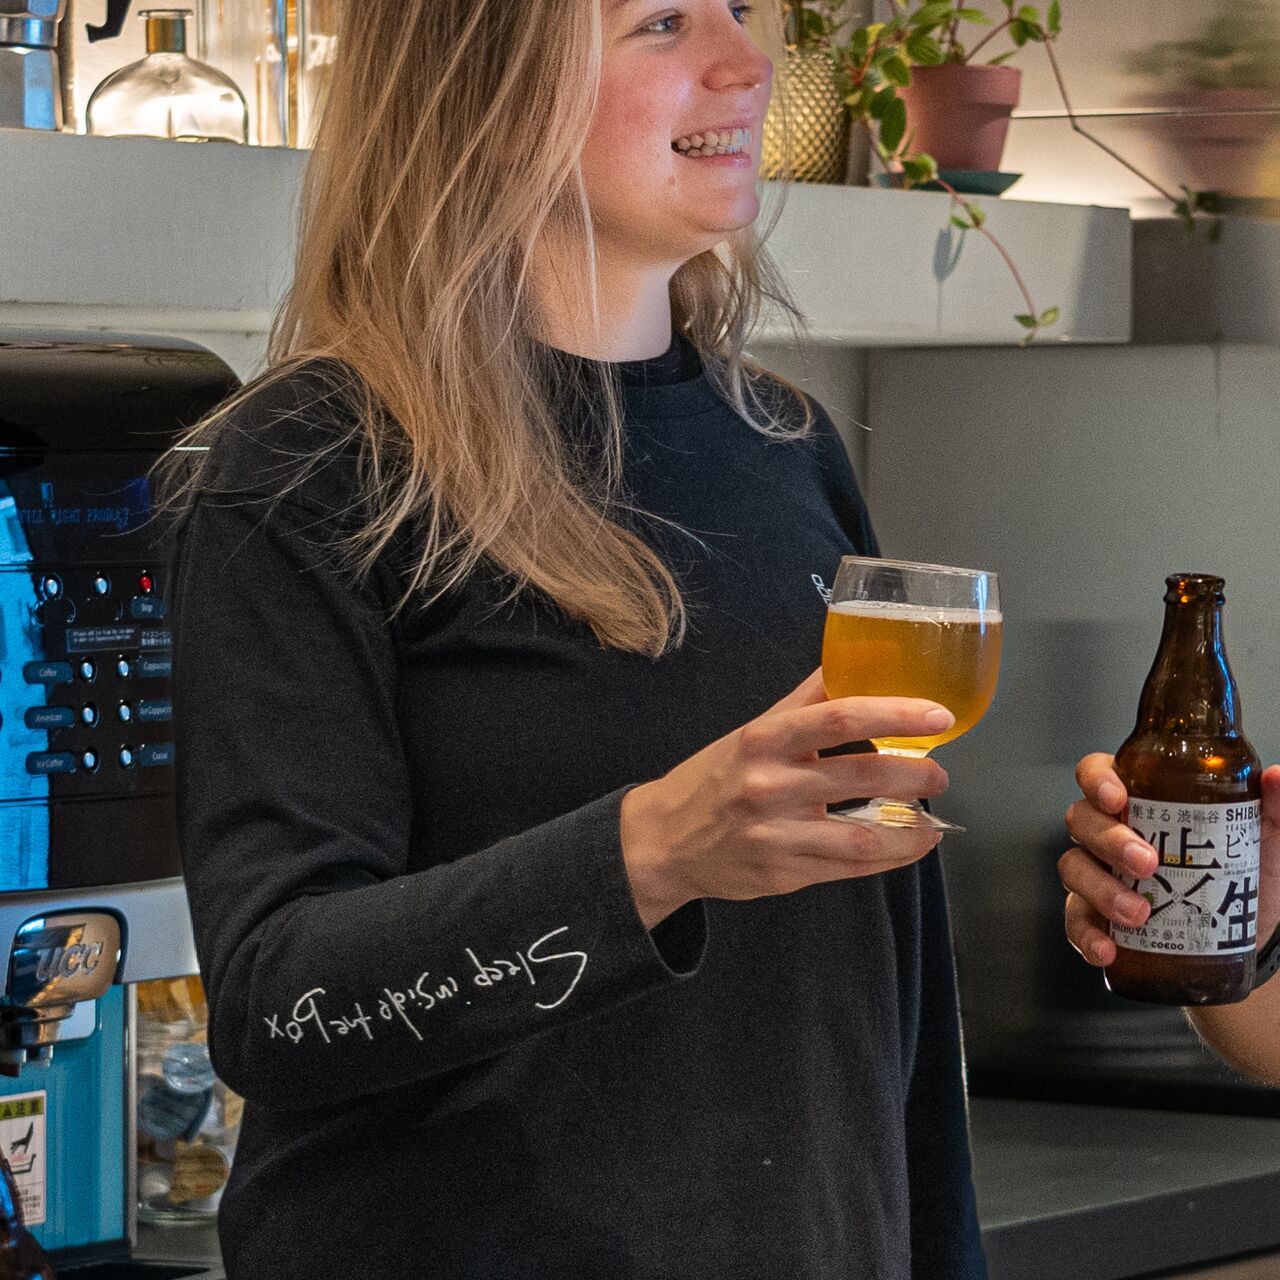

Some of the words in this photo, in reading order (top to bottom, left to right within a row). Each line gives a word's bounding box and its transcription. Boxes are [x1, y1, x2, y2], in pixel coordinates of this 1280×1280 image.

[465, 926, 588, 1010] Sleep
[263, 987, 331, 1045] box
[330, 1002, 373, 1041] the
[375, 972, 458, 1041] inside
